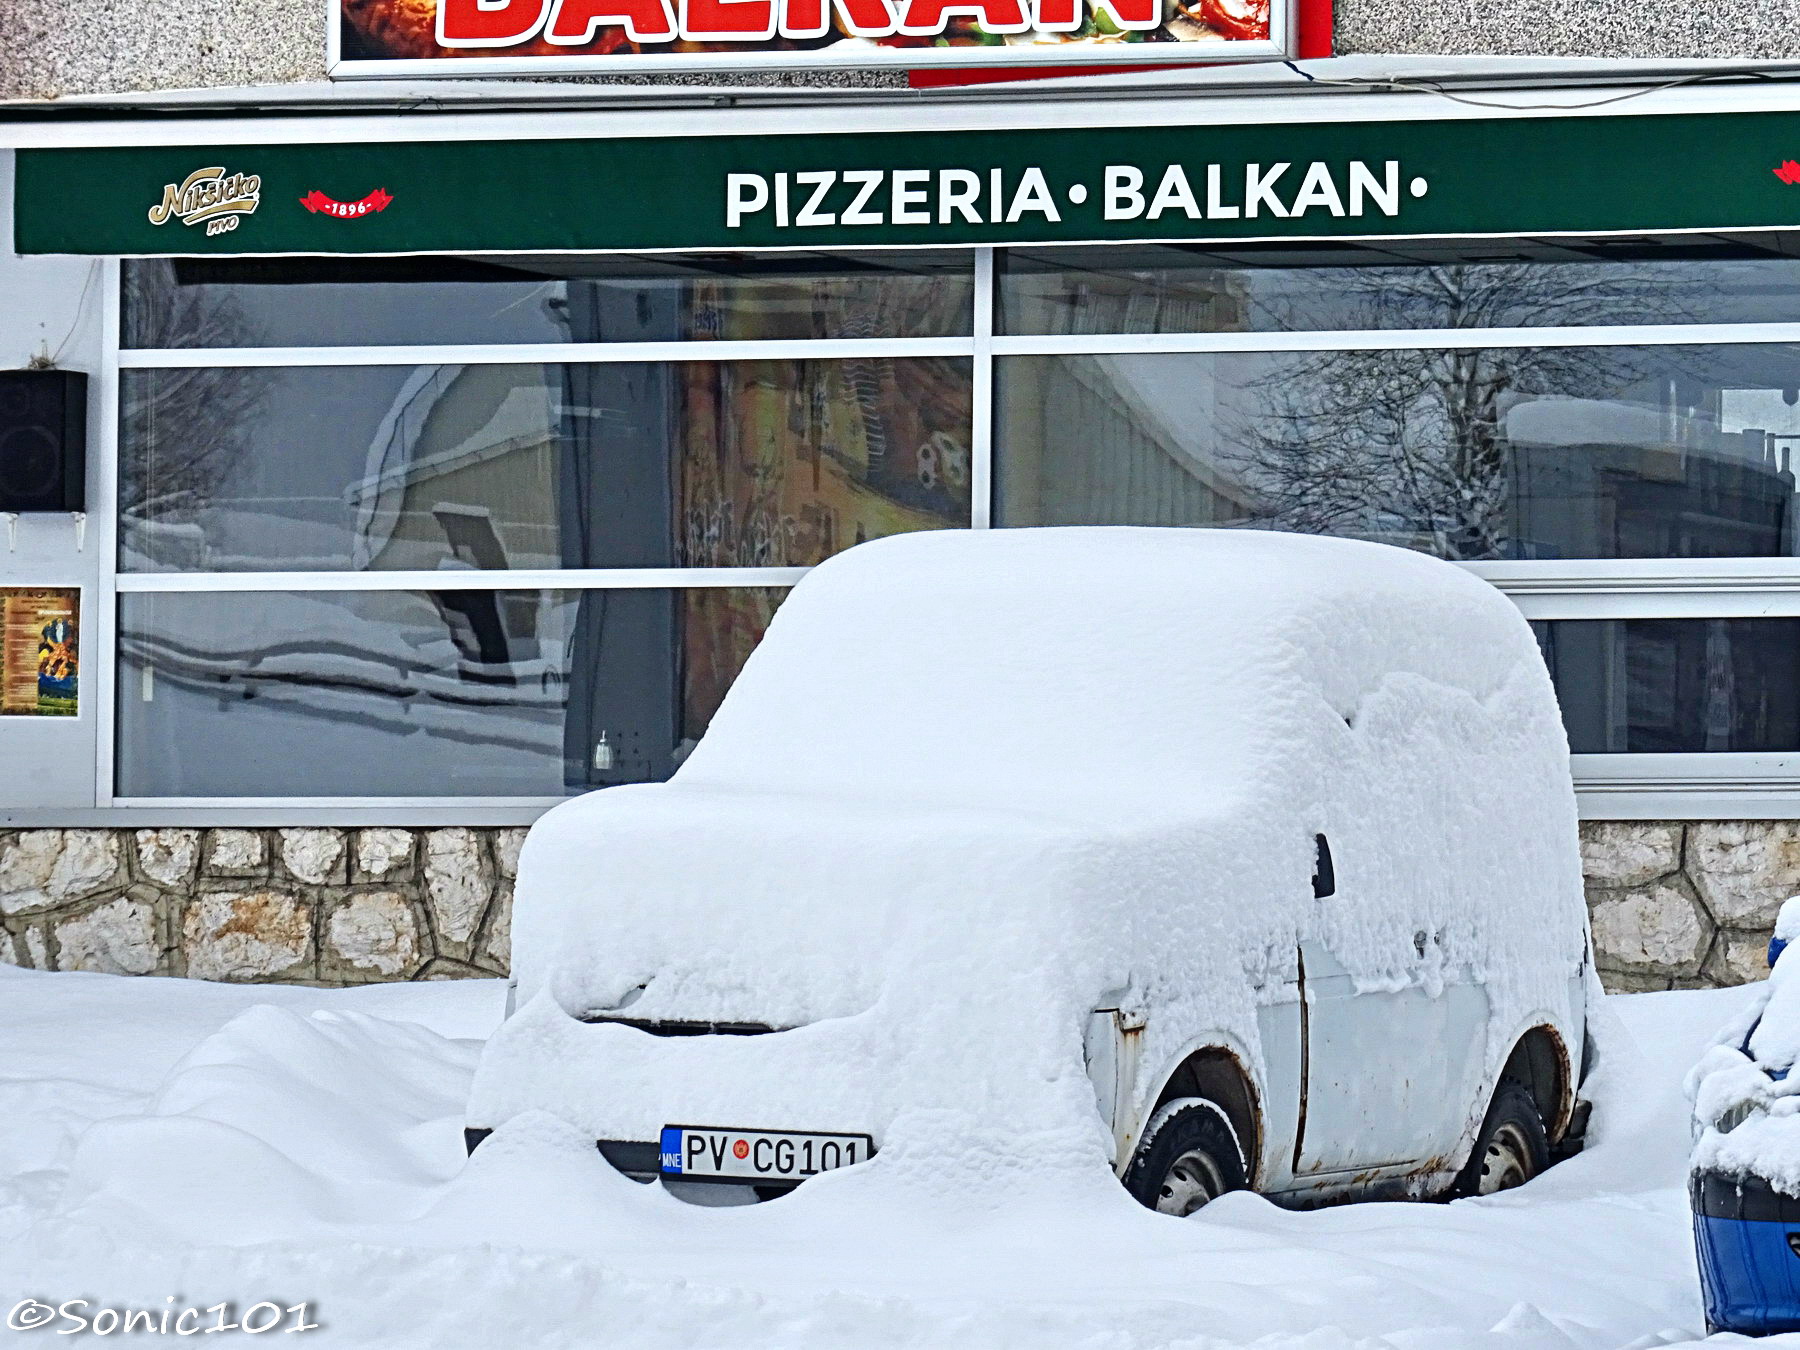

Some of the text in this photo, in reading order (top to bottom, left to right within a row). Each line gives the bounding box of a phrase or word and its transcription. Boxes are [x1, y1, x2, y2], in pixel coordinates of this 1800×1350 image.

[726, 160, 1399, 228] PIZZERIA BALKAN
[206, 215, 240, 236] PIVO
[662, 1152, 682, 1168] MNE
[687, 1134, 857, 1175] PV CG101
